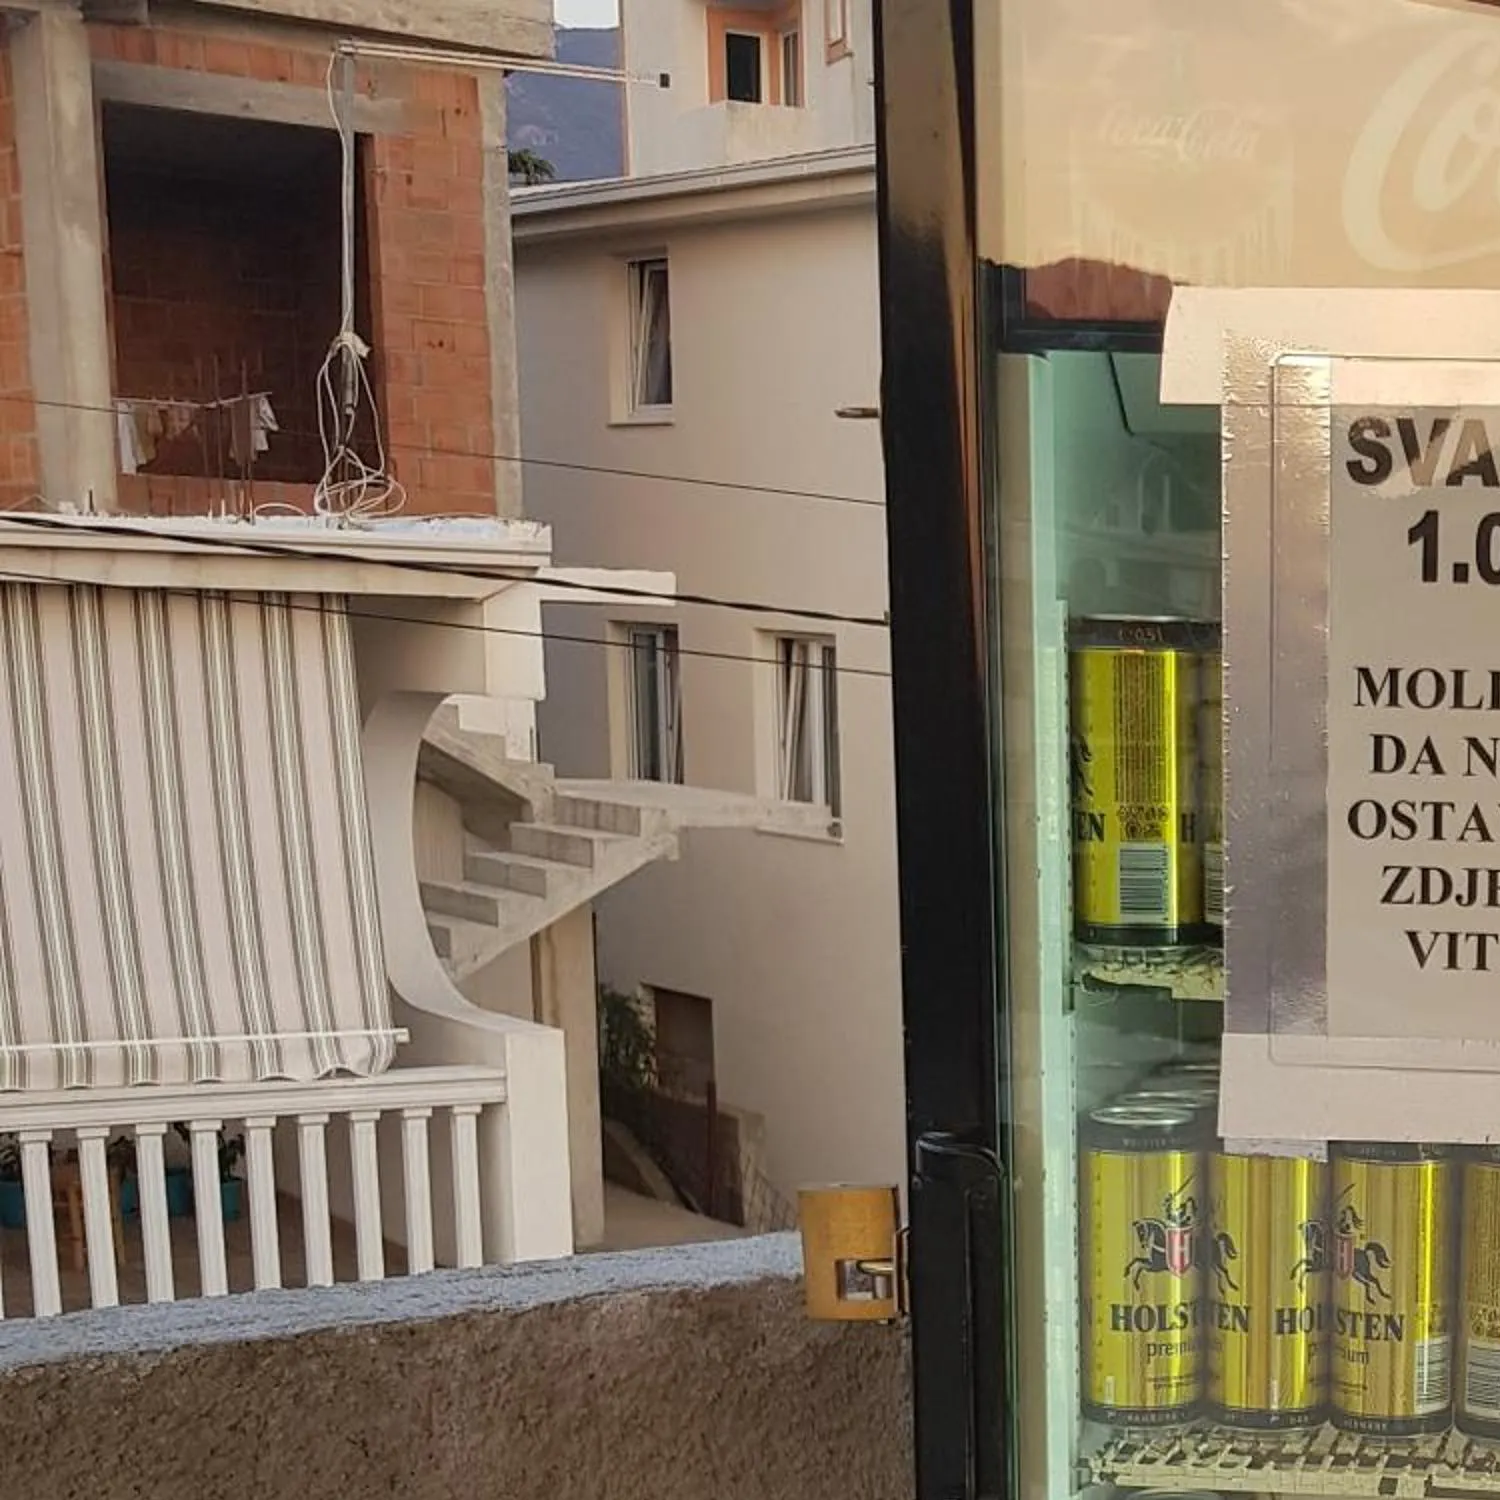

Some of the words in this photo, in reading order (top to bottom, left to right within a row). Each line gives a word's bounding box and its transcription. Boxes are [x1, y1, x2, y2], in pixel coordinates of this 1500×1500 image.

[1346, 416, 1500, 488] SVA
[1370, 734, 1445, 775] DA
[1337, 1309, 1405, 1342] STEN
